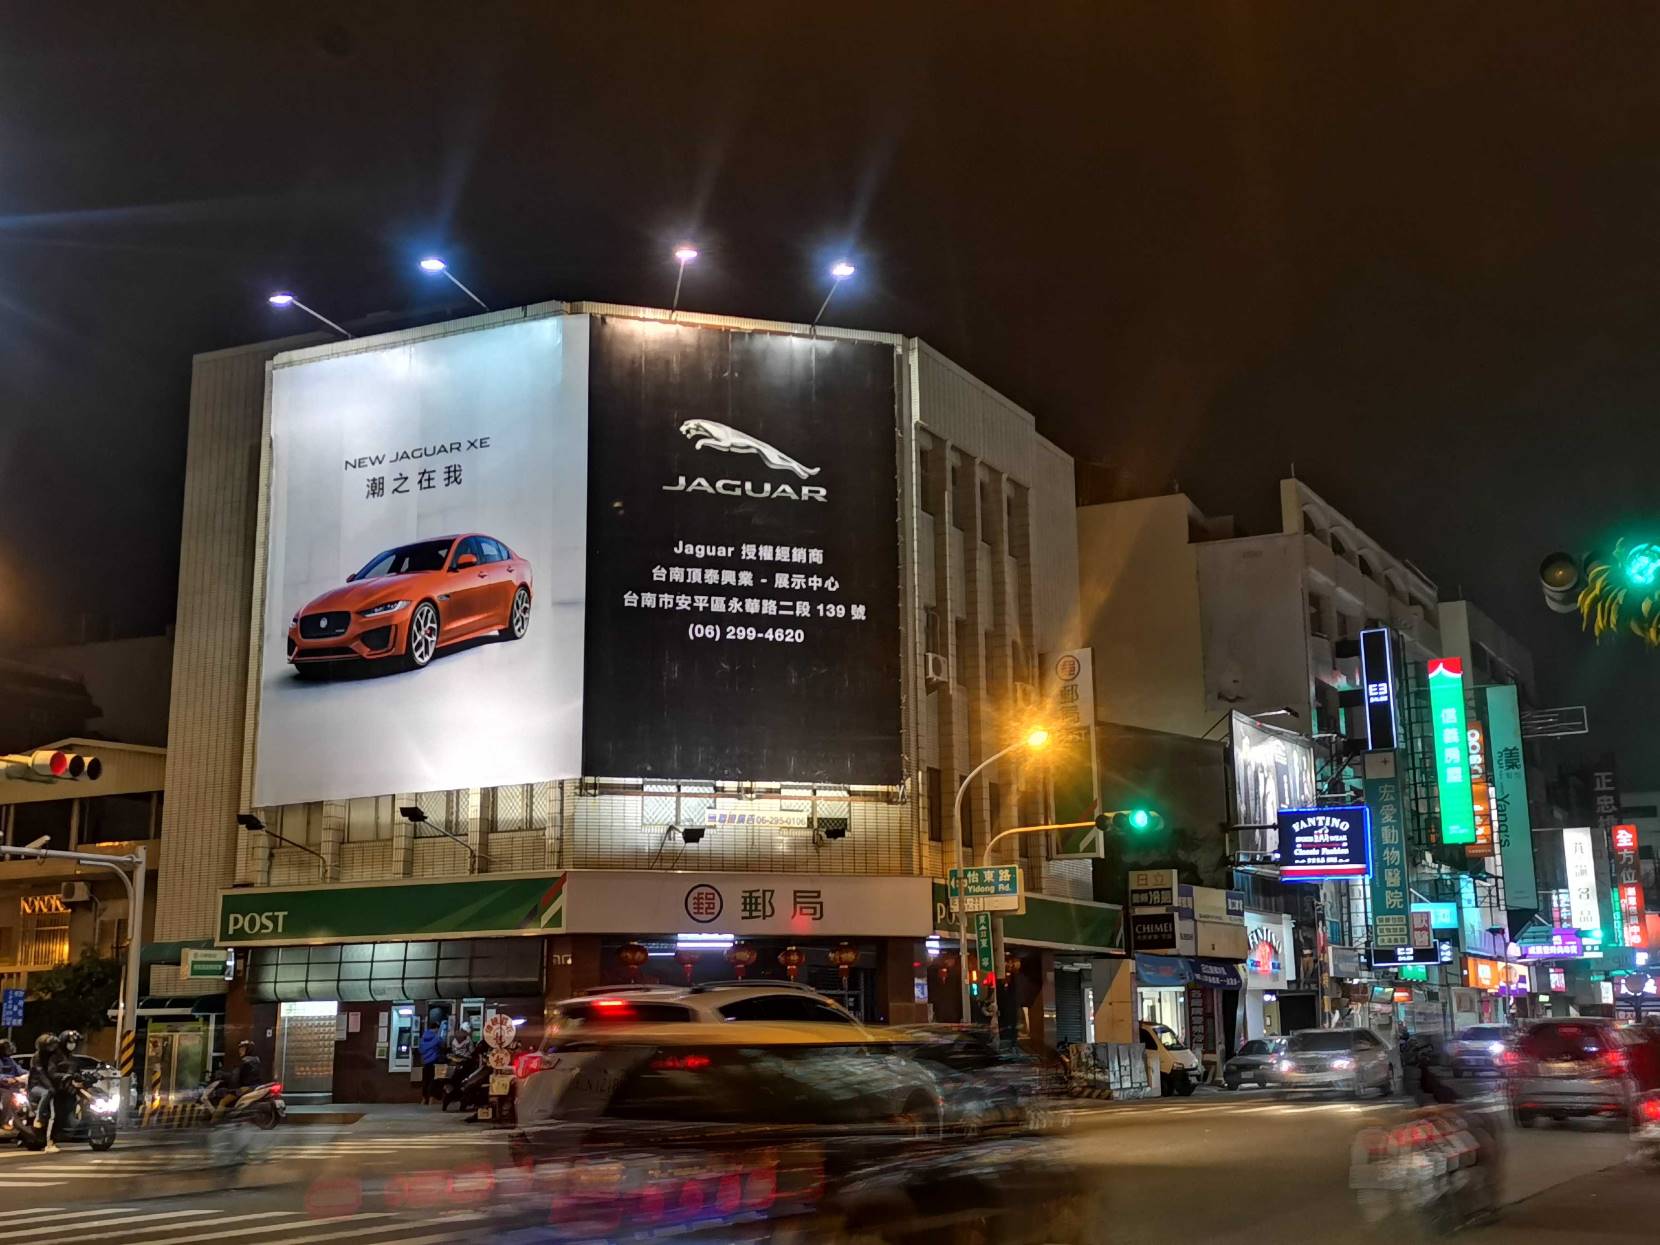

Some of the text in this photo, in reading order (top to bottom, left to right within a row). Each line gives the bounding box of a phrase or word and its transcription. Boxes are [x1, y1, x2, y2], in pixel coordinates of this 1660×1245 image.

[344, 436, 491, 471] NEW JAGUAR XE
[365, 463, 463, 499] 潮之在我
[662, 475, 828, 502] JAGUAR
[674, 540, 824, 565] Jaguar 授權經銷商
[652, 565, 754, 587] 台南頂泰興業
[774, 573, 840, 591] 展示中心
[623, 590, 866, 620] 台南市安平區永華路二段 139 號
[688, 623, 805, 643] (06) 299-4620
[1292, 816, 1350, 832] FANTINO
[1378, 784, 1404, 909] 宏愛動物醫院
[967, 869, 1011, 884] 怡東路
[967, 885, 995, 894] Yidong
[741, 888, 824, 921] 郵局
[228, 911, 288, 935] POST
[1135, 922, 1173, 934] CHIMEI
